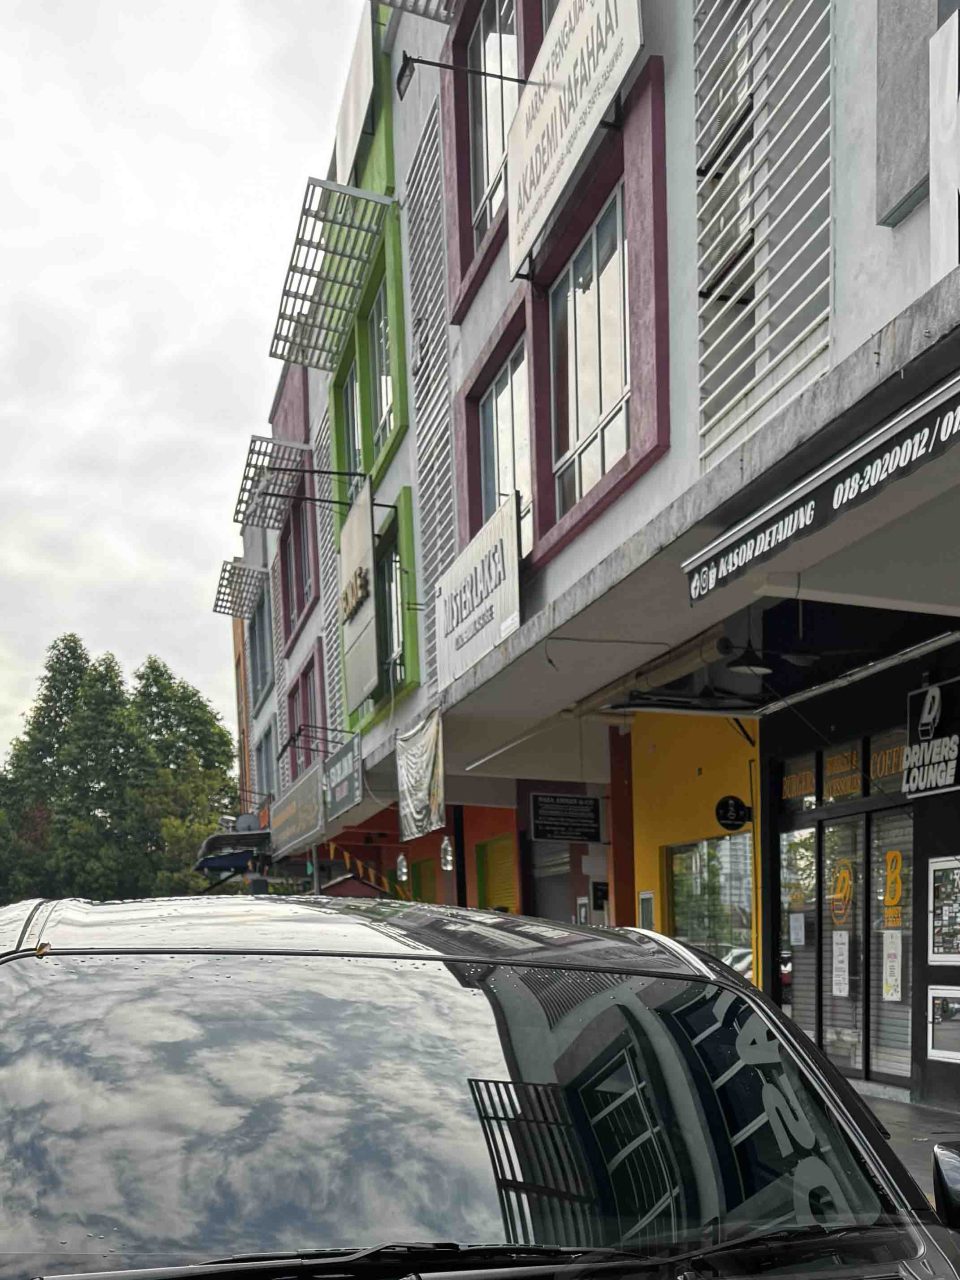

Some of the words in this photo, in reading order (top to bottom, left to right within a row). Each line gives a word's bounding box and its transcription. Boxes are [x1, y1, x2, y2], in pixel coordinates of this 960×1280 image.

[516, 107, 559, 224] AKADEMI
[717, 539, 755, 579] KASOR
[754, 501, 816, 556] DETAILING
[832, 428, 930, 510] 018-2020012
[901, 760, 958, 793] LOUNGE
[902, 735, 960, 770] DRIVERS
